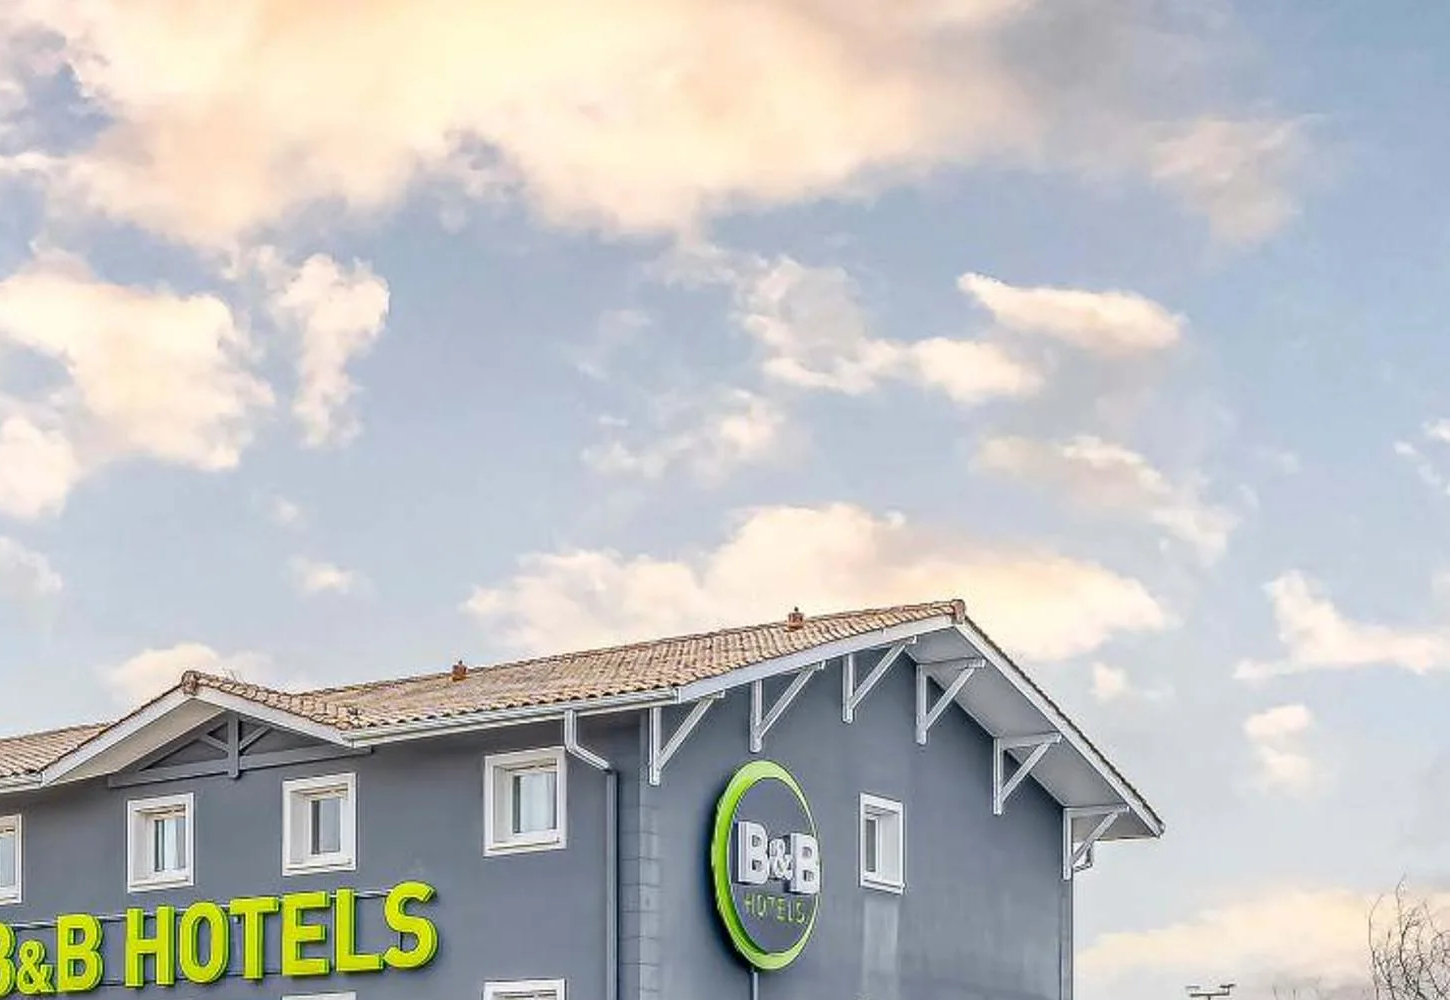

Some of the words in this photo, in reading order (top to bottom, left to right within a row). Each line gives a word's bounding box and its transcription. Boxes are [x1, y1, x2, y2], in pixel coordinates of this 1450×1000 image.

[737, 820, 821, 895] B&B
[124, 880, 440, 989] HOTELS
[743, 892, 806, 925] HOTELS
